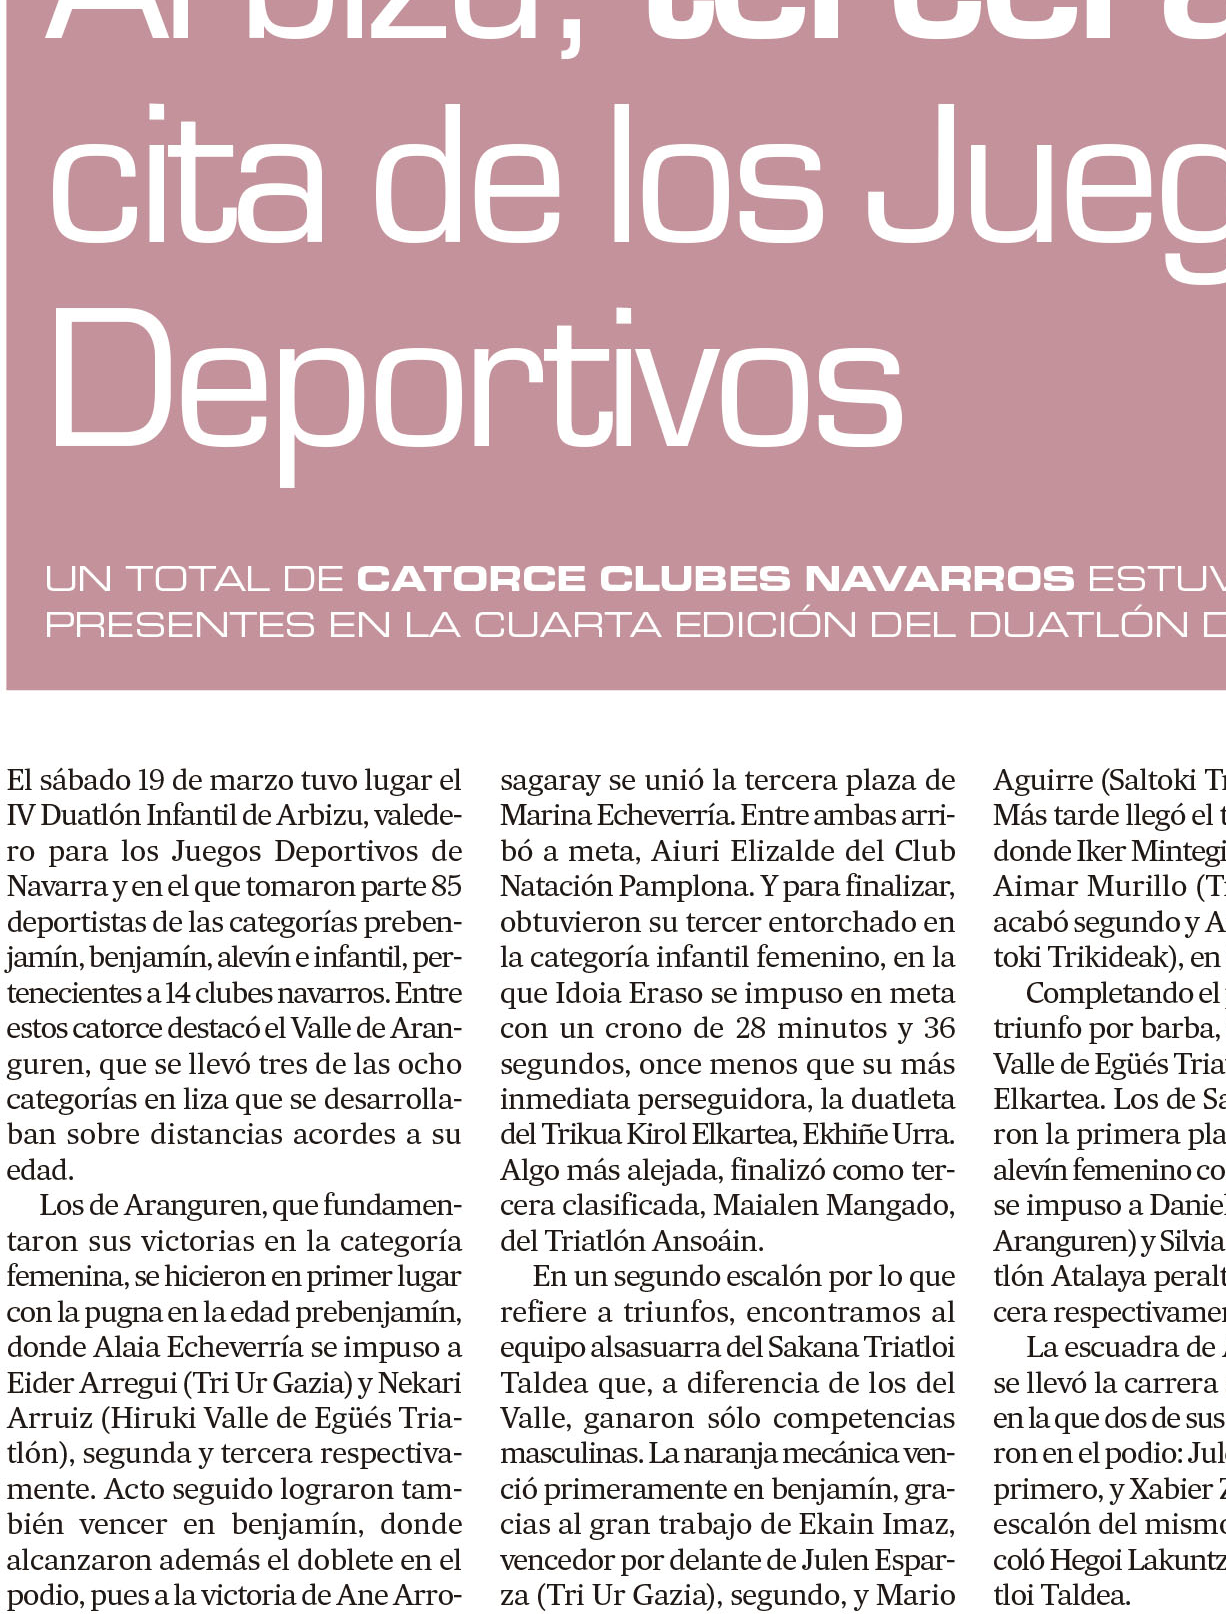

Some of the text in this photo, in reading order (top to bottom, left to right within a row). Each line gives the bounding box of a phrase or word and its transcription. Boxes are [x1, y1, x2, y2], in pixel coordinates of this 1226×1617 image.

[52, 102, 323, 244] cita
[375, 103, 560, 244] de
[613, 103, 824, 244] los
[55, 307, 903, 489] Deportivos
[46, 565, 111, 592] UN
[125, 565, 271, 592] TOTAL
[284, 565, 344, 592] DE
[357, 565, 586, 592] CATORCE
[600, 565, 791, 592] CLUBES
[806, 565, 1075, 592] NAVARROS
[46, 611, 315, 638] PRESENTES
[330, 611, 390, 638] EN
[406, 611, 462, 638] LA
[475, 611, 663, 638] CUARTA
[676, 603, 856, 638] EDICIÓN
[871, 611, 957, 638] DEL
[970, 603, 1188, 638] DUATLÓN
[7, 767, 462, 797] El sábado 19 de marzo tuvo lugar el
[500, 1512, 955, 1541] cias al gran trabajo de Ekain Imaz,
[993, 1582, 1131, 1606] tloi Taldea.
